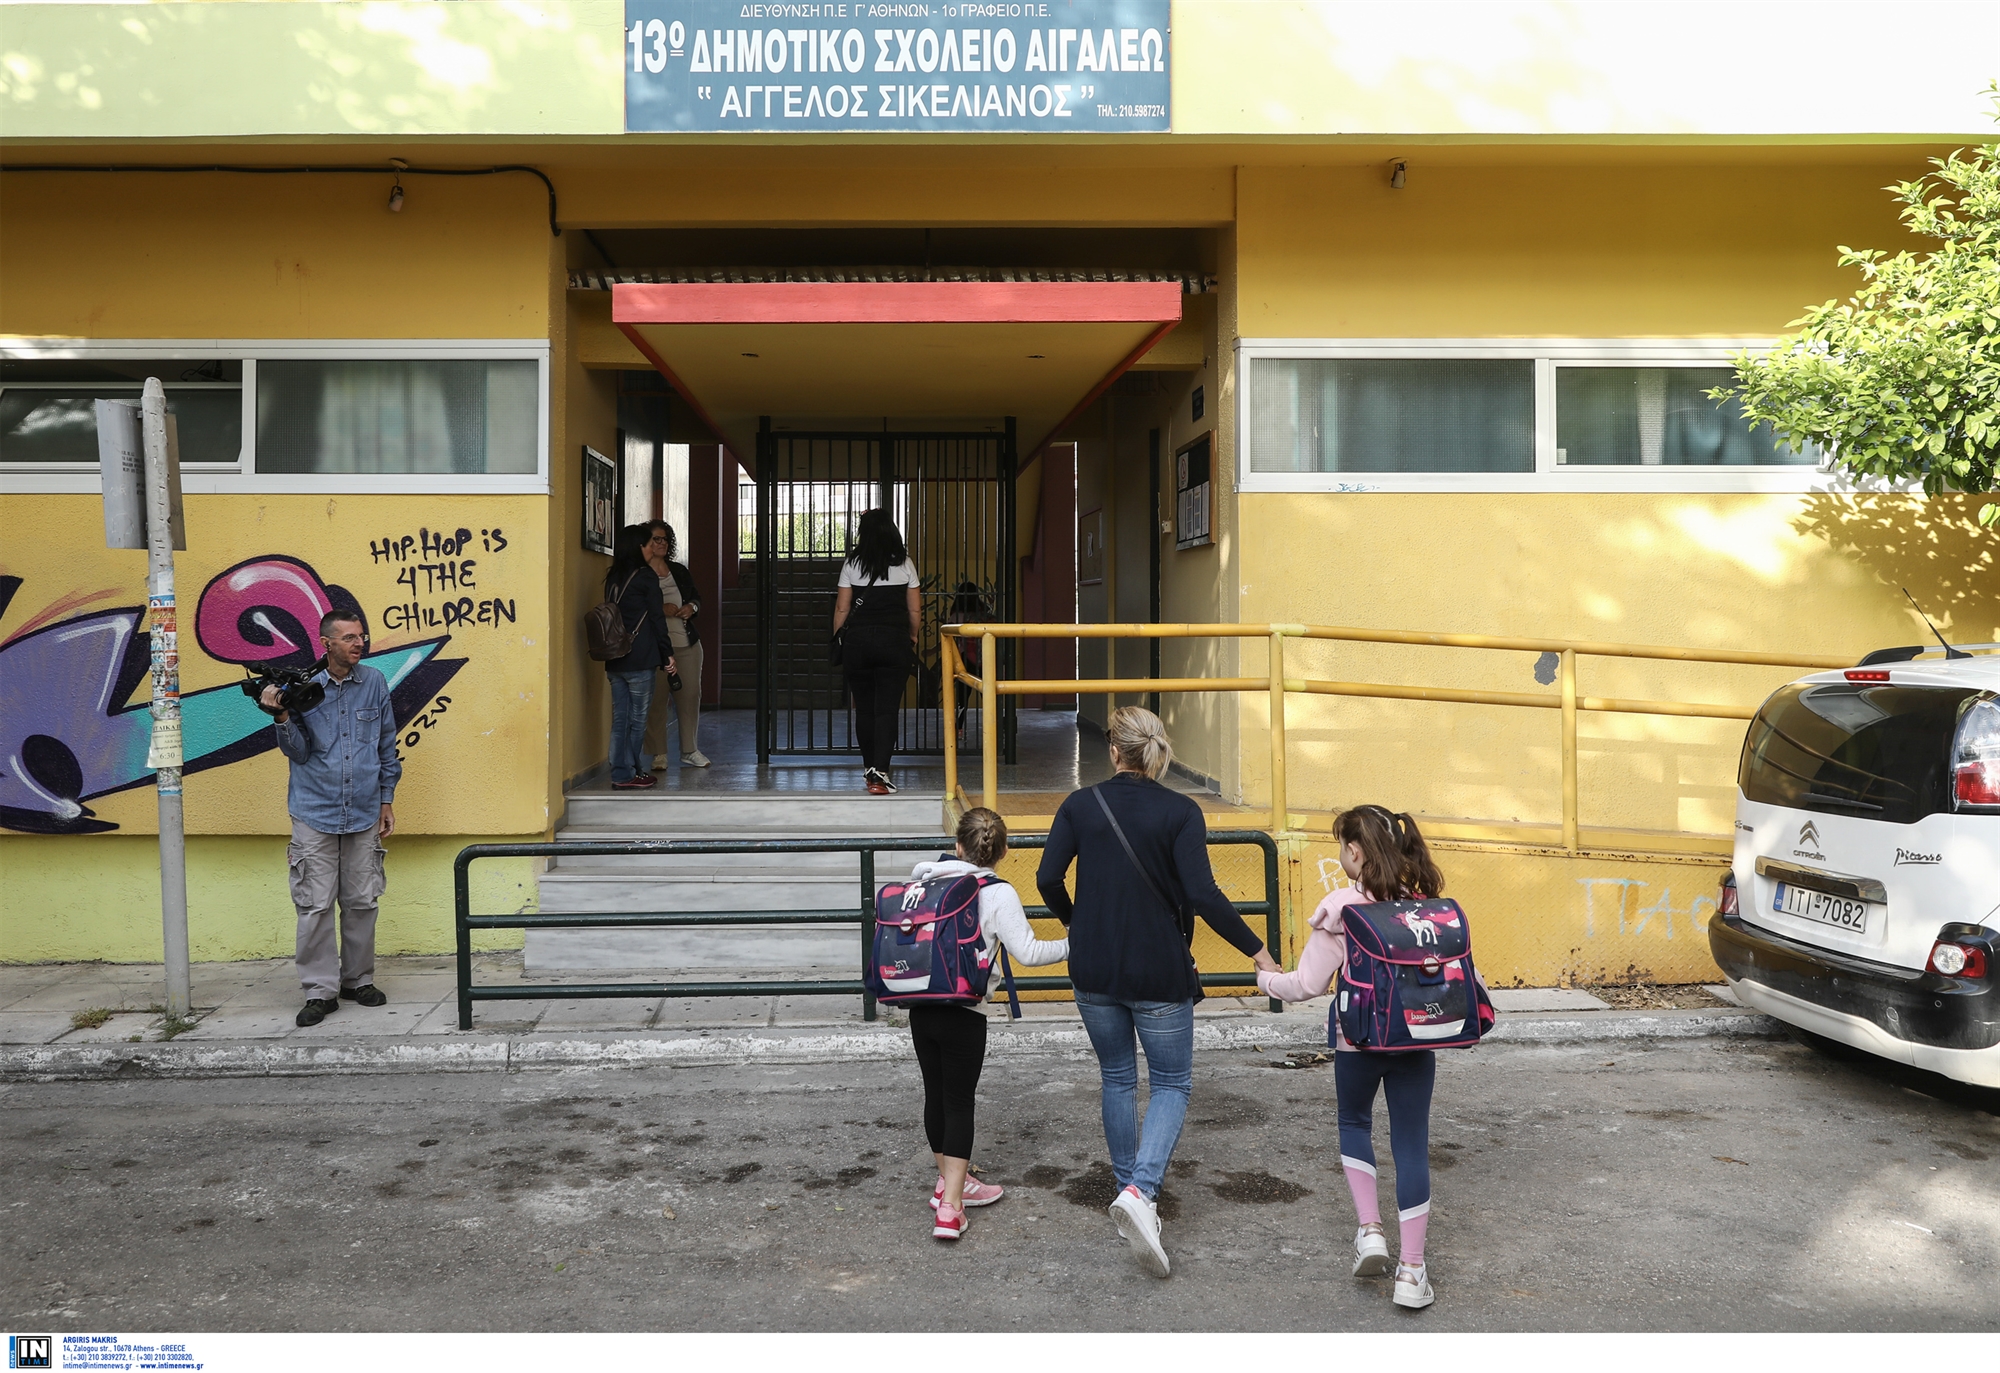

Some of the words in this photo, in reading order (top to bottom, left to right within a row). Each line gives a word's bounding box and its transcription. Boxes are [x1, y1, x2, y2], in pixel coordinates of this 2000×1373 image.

[740, 4, 820, 18] ΔΙΕΥΘΥΝΣΗ
[867, 4, 929, 17] ΑΘΗΝΩΝ
[960, 3, 1021, 17] ΓΡΑΦΕΙΟ
[1024, 4, 1052, 17] Π.Ε.
[689, 28, 866, 74] ΔΗΜΟΤΙΚΟ
[874, 28, 1017, 73] ΣΧΟΛΕΙΟ
[1025, 28, 1165, 73] ΑΙΓΑΛΕΩ
[719, 85, 869, 118] ΑΓΓΕΛΟΣ
[878, 84, 1072, 118] ΣΙΚΕΛΙΑΝΟΣ
[1118, 104, 1166, 118] 210.5987274
[383, 596, 517, 634] CHILDREN
[1893, 847, 1942, 867] Picasso
